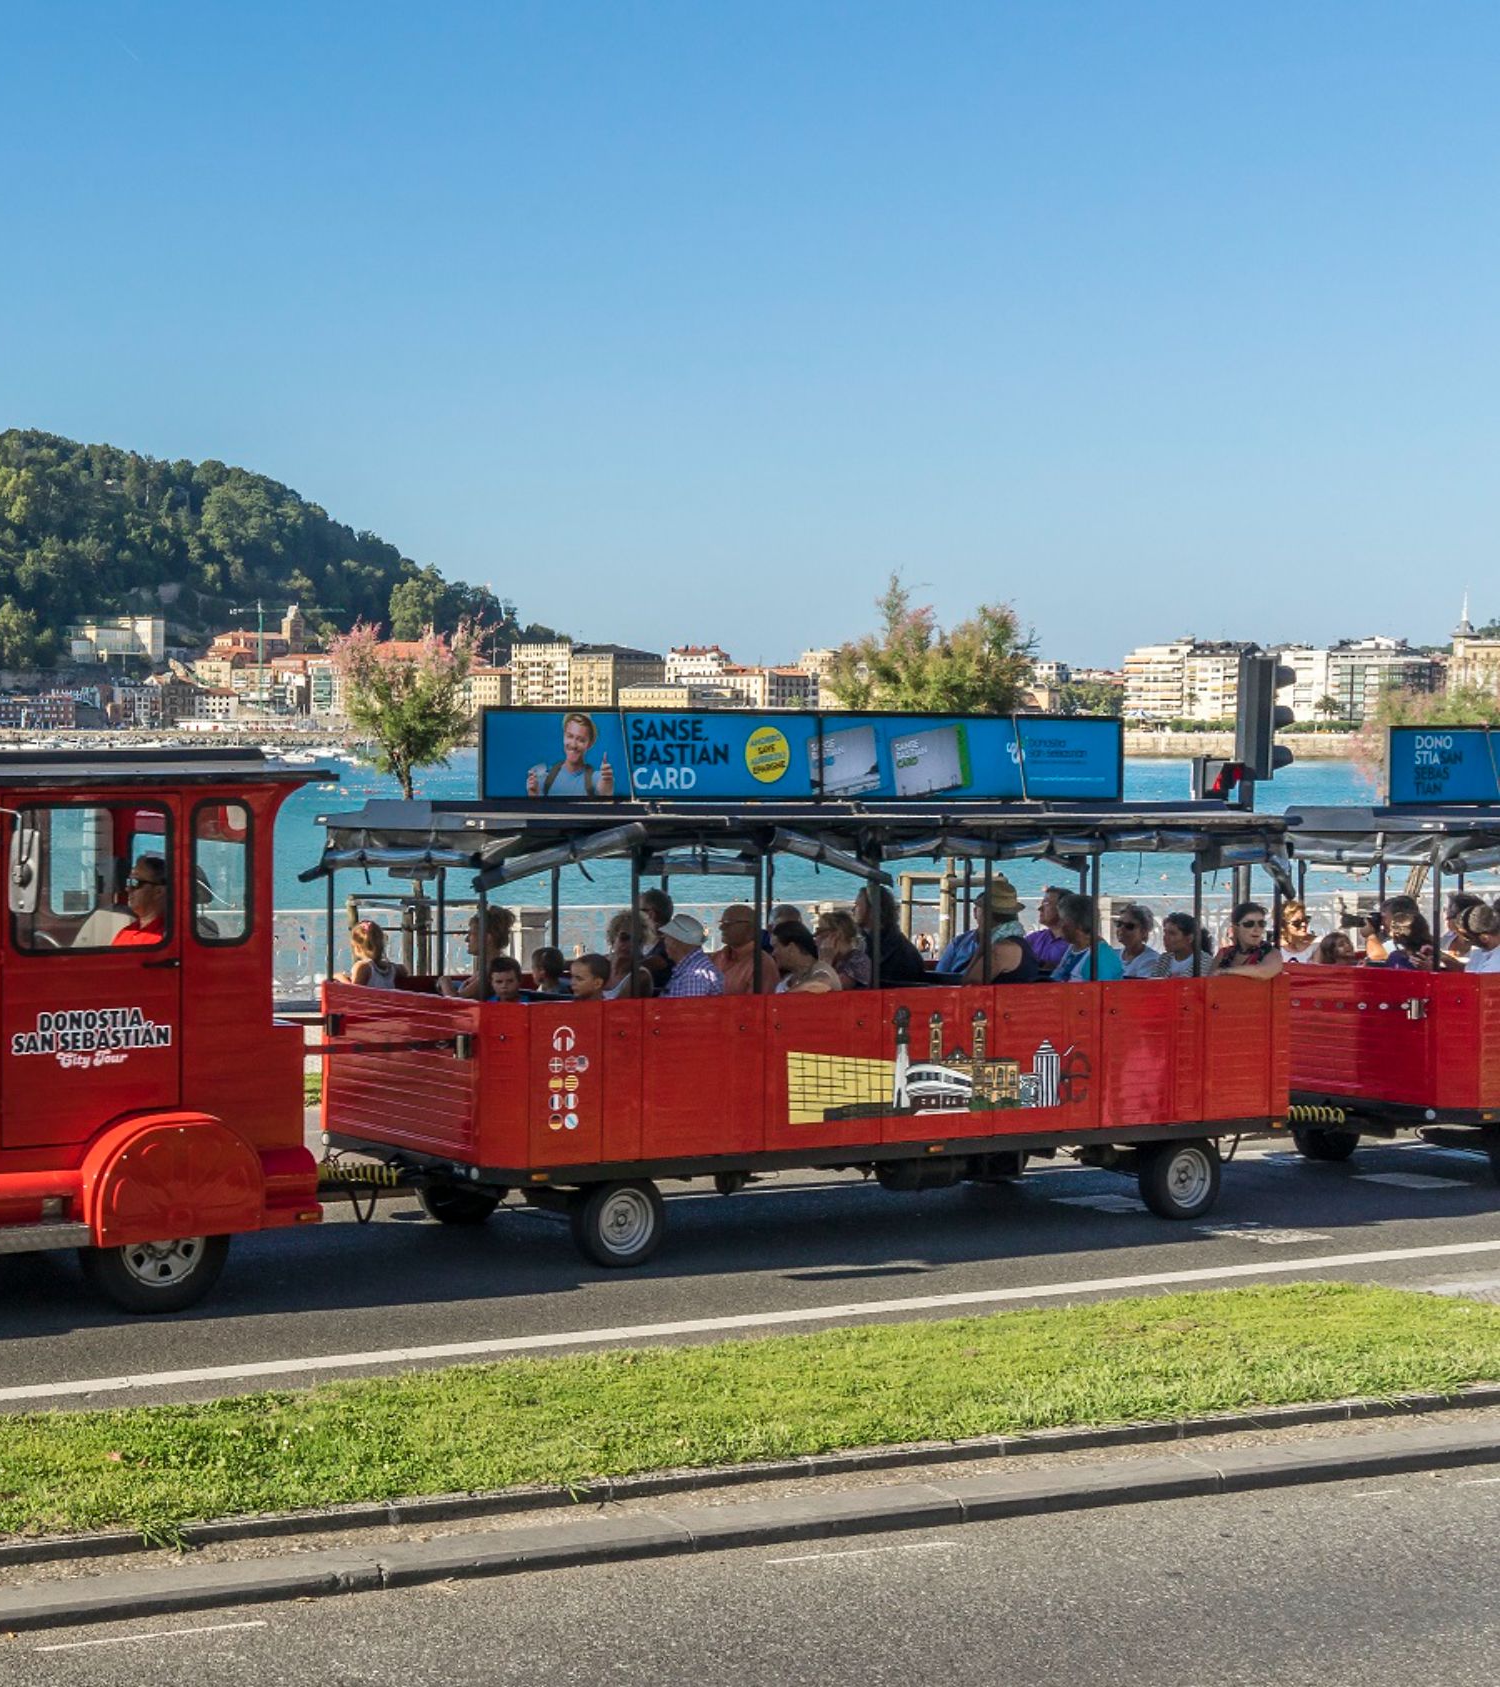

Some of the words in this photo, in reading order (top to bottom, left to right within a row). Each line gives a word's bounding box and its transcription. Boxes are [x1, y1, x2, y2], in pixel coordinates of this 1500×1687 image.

[632, 719, 703, 741] SANSE
[1415, 736, 1453, 749] DONO
[632, 767, 697, 790] CARD
[1415, 767, 1449, 780] SEBAS
[37, 1007, 144, 1033] DONOSTIA
[11, 1032, 56, 1055] SAN
[57, 1020, 172, 1052] SEBASTIÁN
[55, 1051, 91, 1068] City
[93, 1049, 128, 1067] Tour
